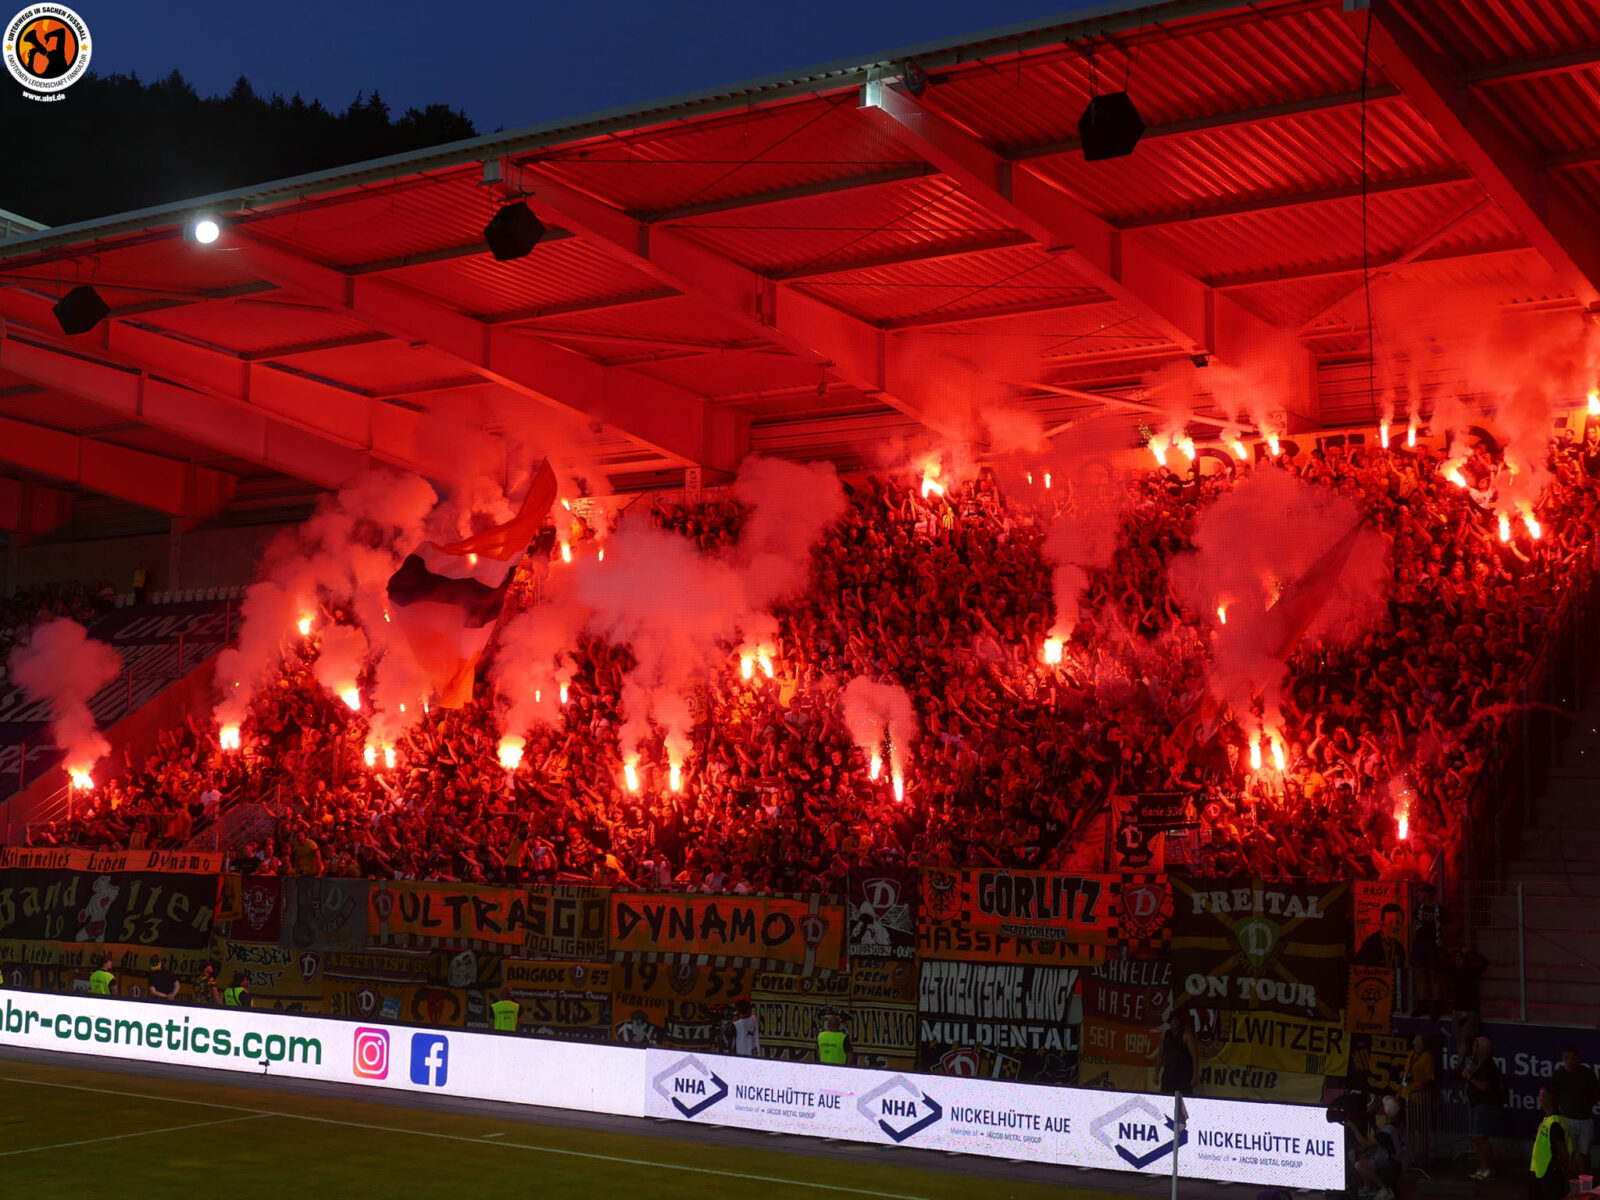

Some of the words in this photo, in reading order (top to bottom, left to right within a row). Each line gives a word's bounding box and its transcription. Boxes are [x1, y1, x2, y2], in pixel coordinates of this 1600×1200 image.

[977, 869, 1101, 925] GÖRLITZ
[1190, 887, 1325, 919] FREITAL
[616, 902, 796, 947] DYNAMO
[506, 966, 566, 983] BRIGADE
[591, 969, 610, 986] 53
[621, 960, 659, 992] 19
[706, 965, 747, 998] 53
[919, 960, 1024, 1020] OSTDEUTSCHE
[1184, 973, 1230, 998] ON
[1236, 976, 1318, 1008] TOUR
[853, 984, 900, 999] DYNAMO
[1098, 986, 1145, 1021] HASE
[0, 999, 322, 1065] br-cosmetics.com
[850, 1009, 916, 1046] DYNAMO
[921, 1019, 1079, 1051] MULDENTAL
[1089, 1025, 1117, 1050] SEIT
[674, 1077, 706, 1096] NHA
[1200, 1065, 1279, 1090] ANCLUB
[735, 1084, 815, 1107] NICKELHÜTTE
[818, 1093, 841, 1110] AUE
[882, 1098, 918, 1119] NHA
[950, 1105, 1041, 1131] NICKELHÜTTE
[1044, 1117, 1072, 1134] AUE
[1118, 1122, 1160, 1143] NHA
[1198, 1129, 1300, 1155] NICKELHÜTTE
[1305, 1139, 1336, 1157] AUE
[1239, 1157, 1258, 1166] JACOB
[1259, 1158, 1280, 1167] METAL
[1281, 1160, 1303, 1168] GROUP
